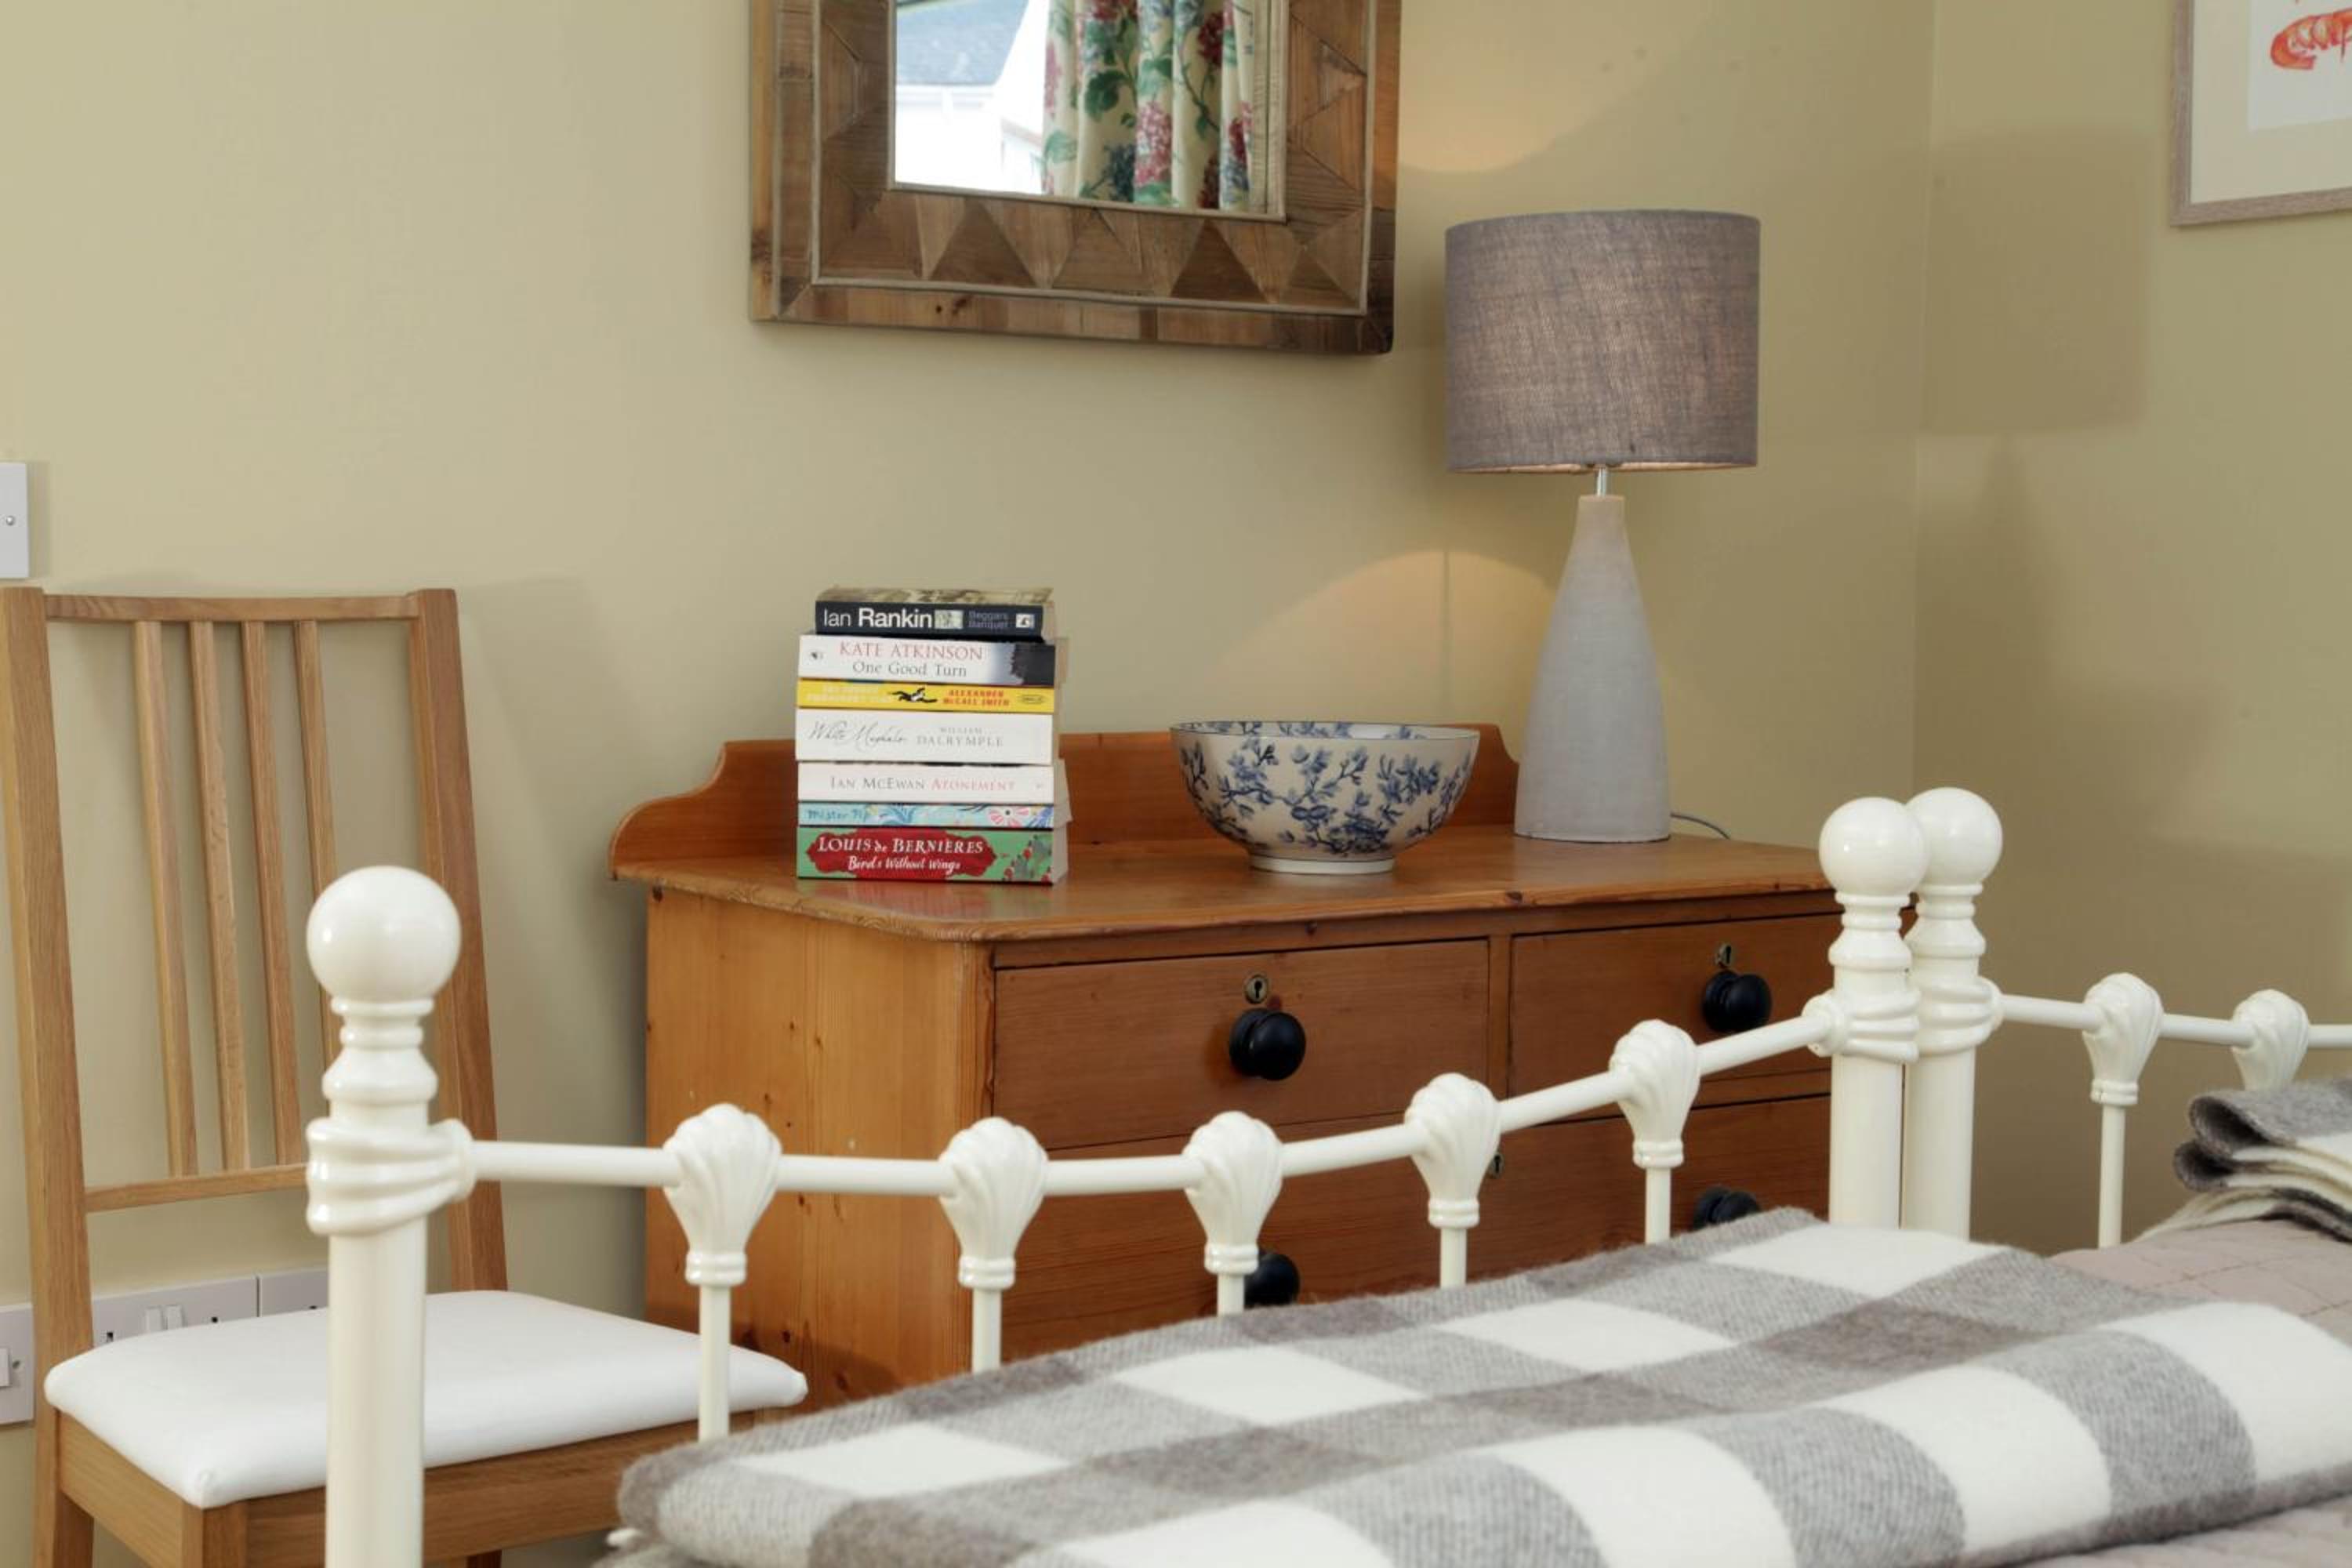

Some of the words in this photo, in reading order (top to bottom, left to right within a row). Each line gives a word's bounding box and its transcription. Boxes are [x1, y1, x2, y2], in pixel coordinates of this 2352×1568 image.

[824, 608, 851, 626] Ian
[858, 607, 933, 628] Rankin
[840, 641, 884, 657] KATE
[891, 644, 982, 660] ATKINSON
[852, 661, 883, 674] One
[888, 661, 927, 676] Good
[935, 663, 967, 677] Turn
[916, 735, 1004, 747] DALRYMPLE
[817, 837, 871, 852] LOUIS
[874, 840, 887, 852] de
[848, 855, 882, 871] Birds
[885, 855, 926, 870] Without
